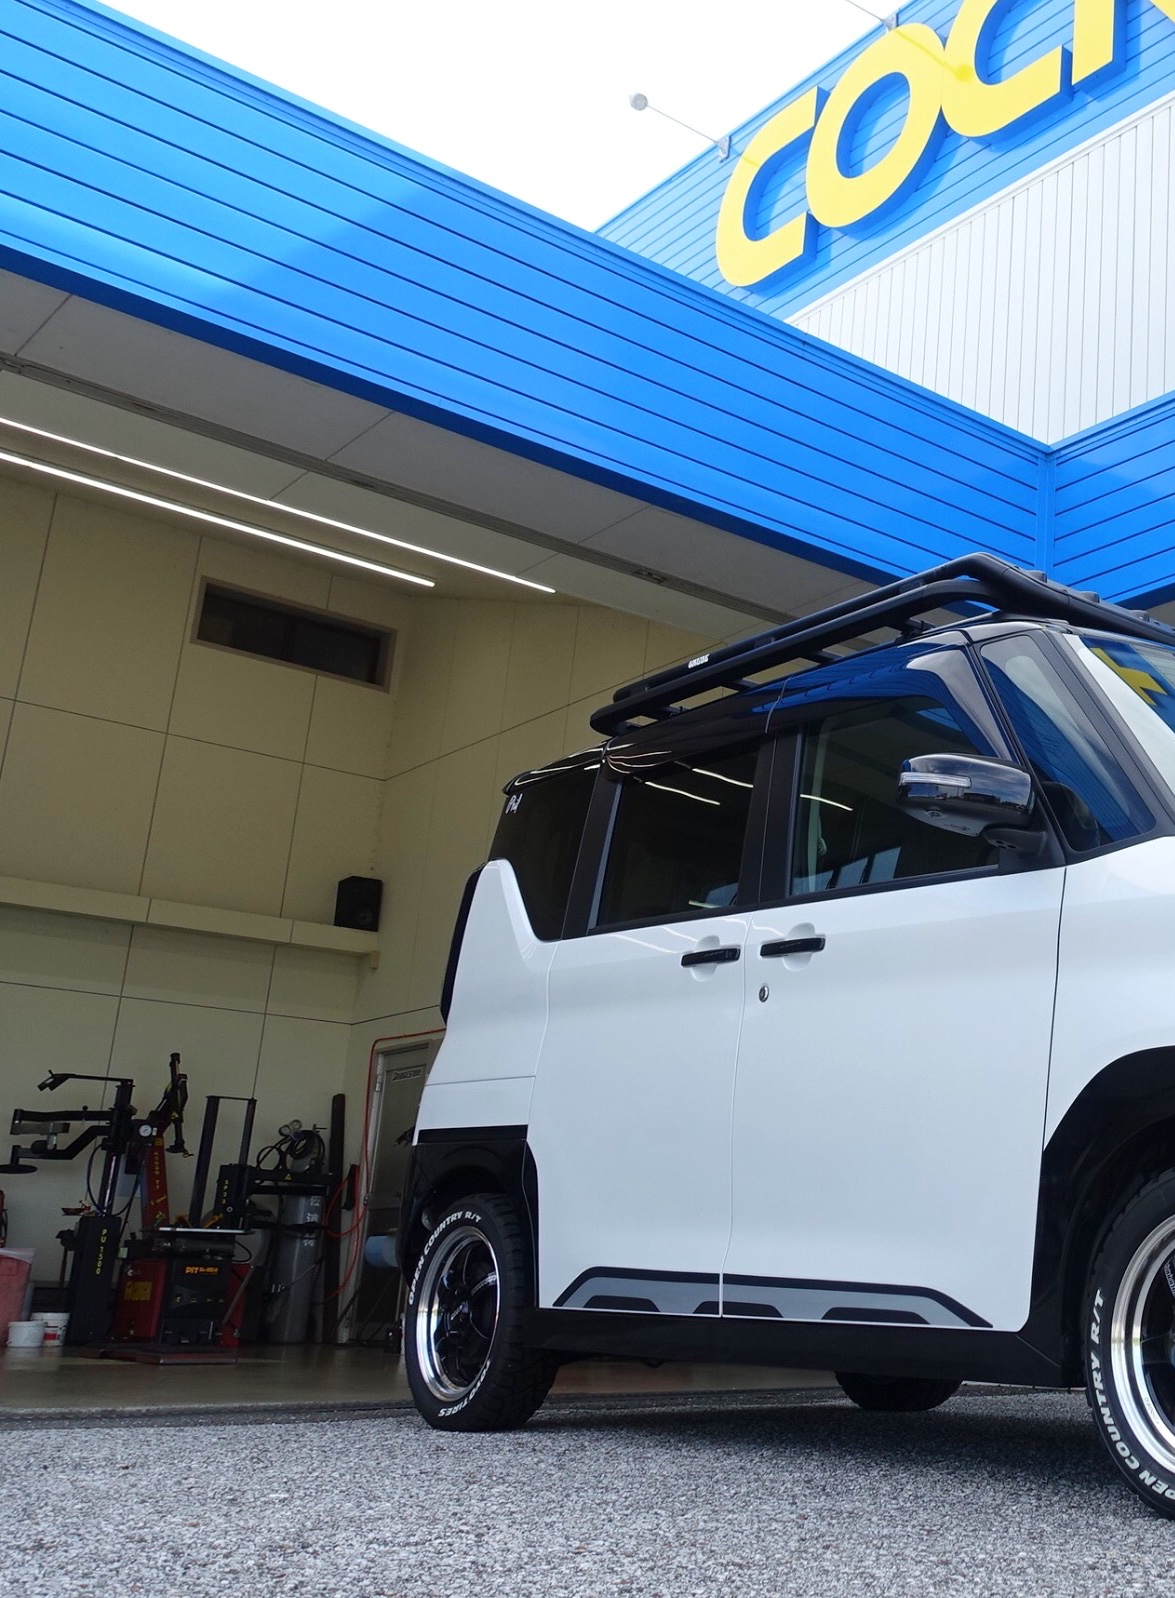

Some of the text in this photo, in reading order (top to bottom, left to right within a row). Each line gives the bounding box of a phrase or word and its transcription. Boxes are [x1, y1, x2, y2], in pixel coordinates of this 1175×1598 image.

[408, 1255, 426, 1306] OPEN
[423, 1211, 464, 1256] COUNTRY
[1089, 1288, 1105, 1347] R/T
[437, 1397, 468, 1418] TIRES
[1089, 1352, 1141, 1471] COUNTRY
